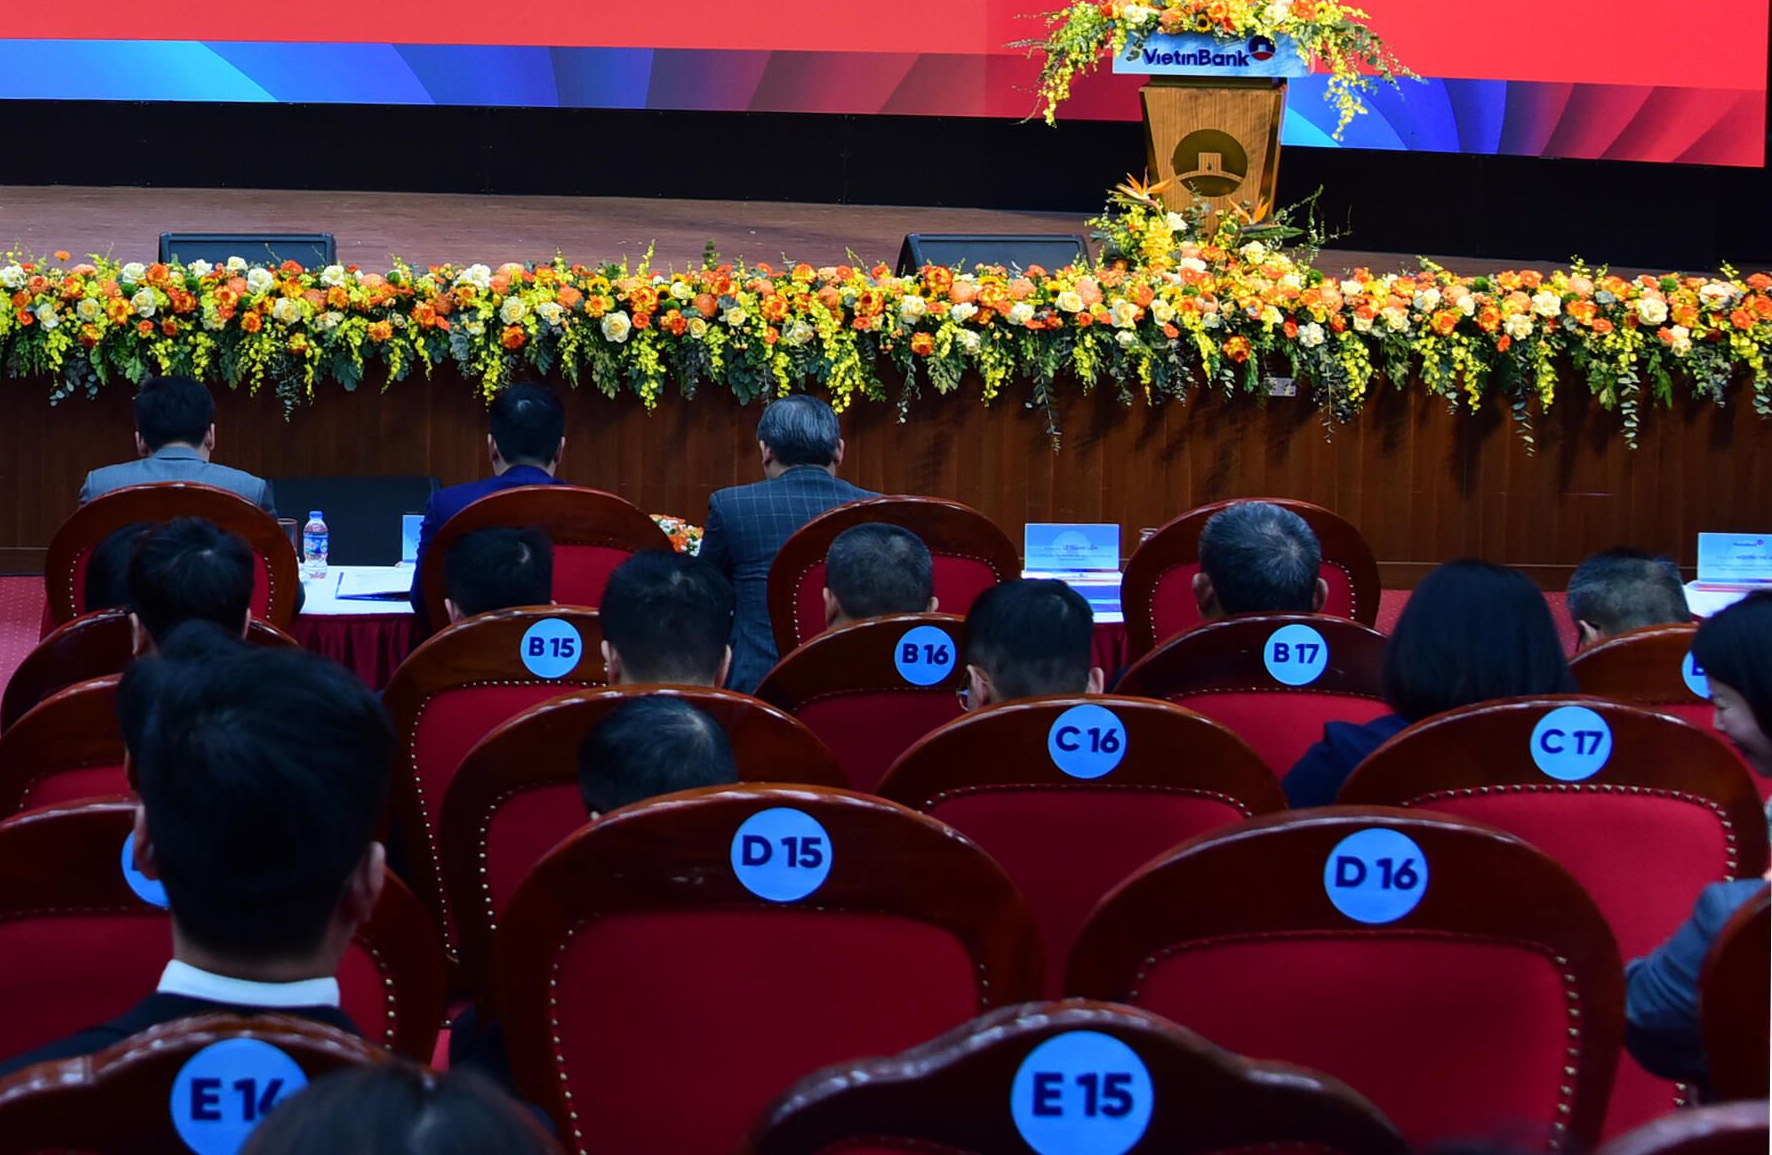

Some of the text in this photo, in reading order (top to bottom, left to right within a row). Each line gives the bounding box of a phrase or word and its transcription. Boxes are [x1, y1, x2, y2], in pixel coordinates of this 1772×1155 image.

[1142, 48, 1250, 67] VietinBank
[528, 636, 575, 658] B 15
[901, 643, 949, 666] B 16
[1273, 642, 1320, 664] B 17
[1055, 725, 1120, 754] C 16
[1540, 728, 1603, 755] C 17
[741, 834, 823, 869] D 15
[1335, 855, 1419, 891] D 16
[190, 1077, 223, 1122] E
[1032, 1071, 1134, 1119] E 15
